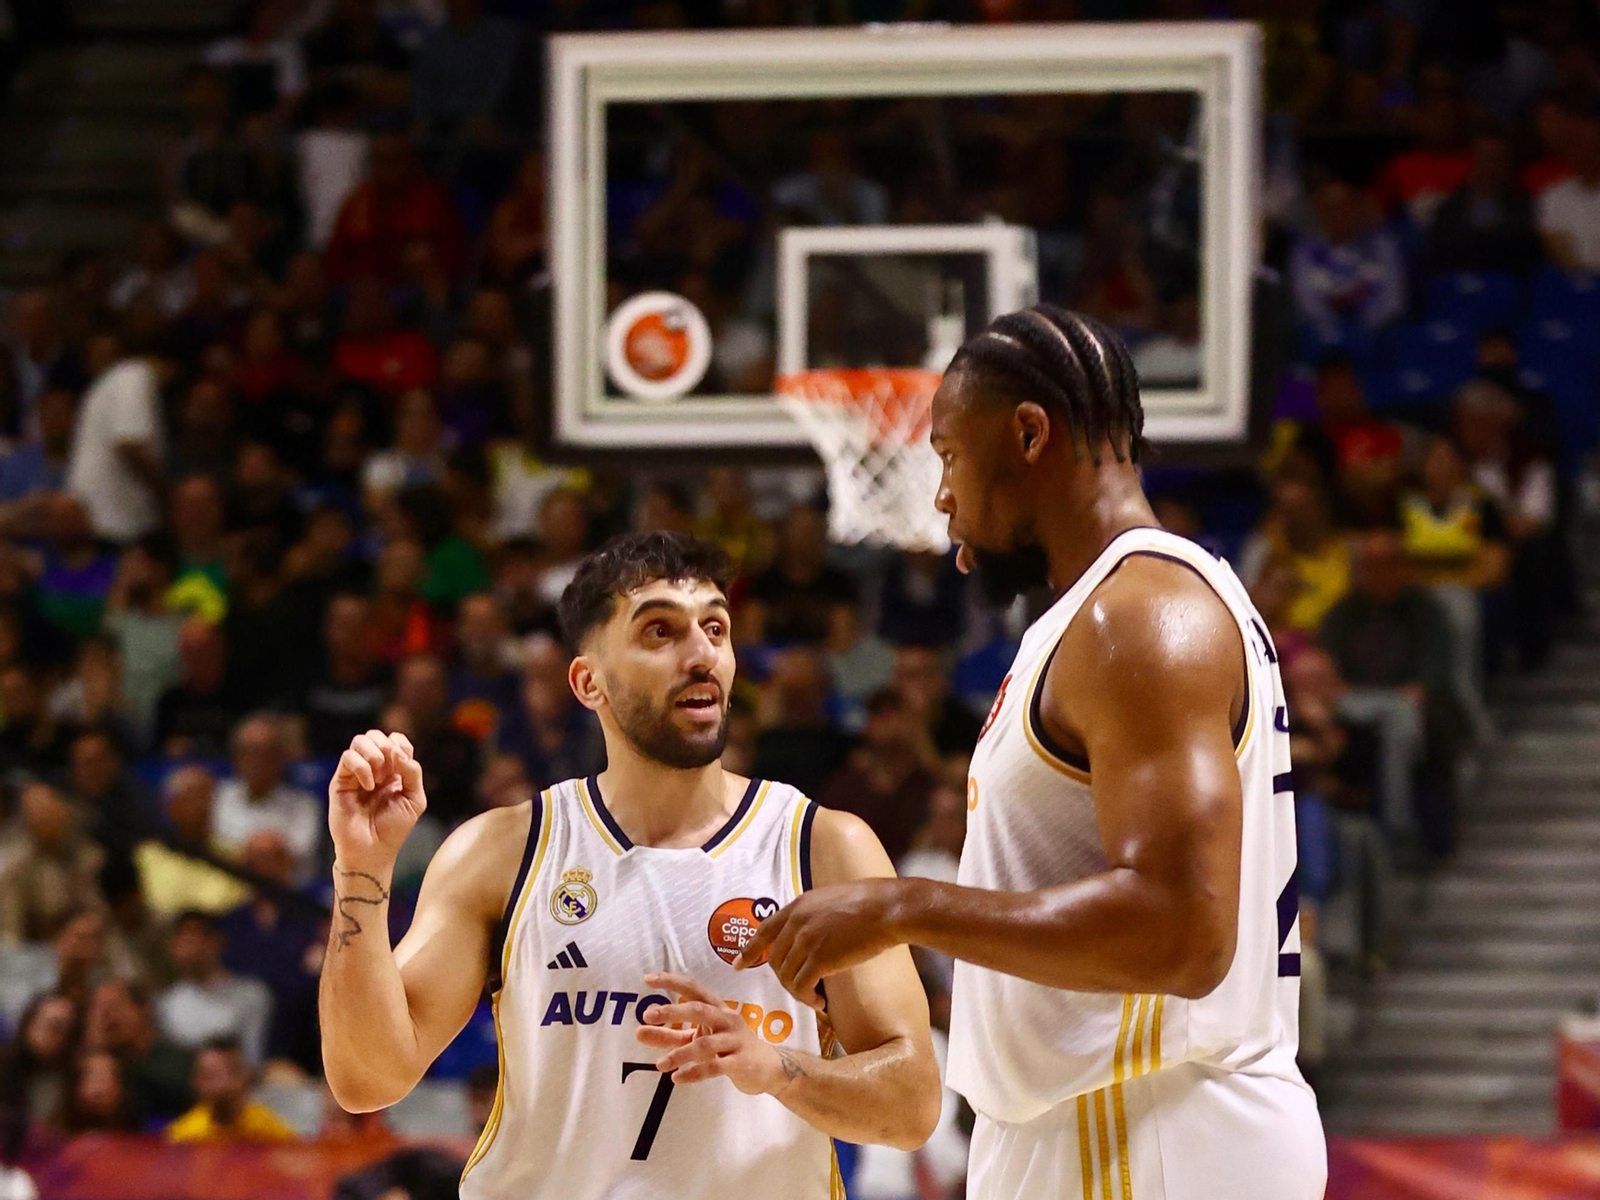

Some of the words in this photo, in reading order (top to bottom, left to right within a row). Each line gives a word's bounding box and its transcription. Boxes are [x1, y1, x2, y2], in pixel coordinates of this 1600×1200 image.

[729, 917, 749, 926] acb
[540, 990, 794, 1043] AUTORO
[621, 1062, 682, 1161] 7
